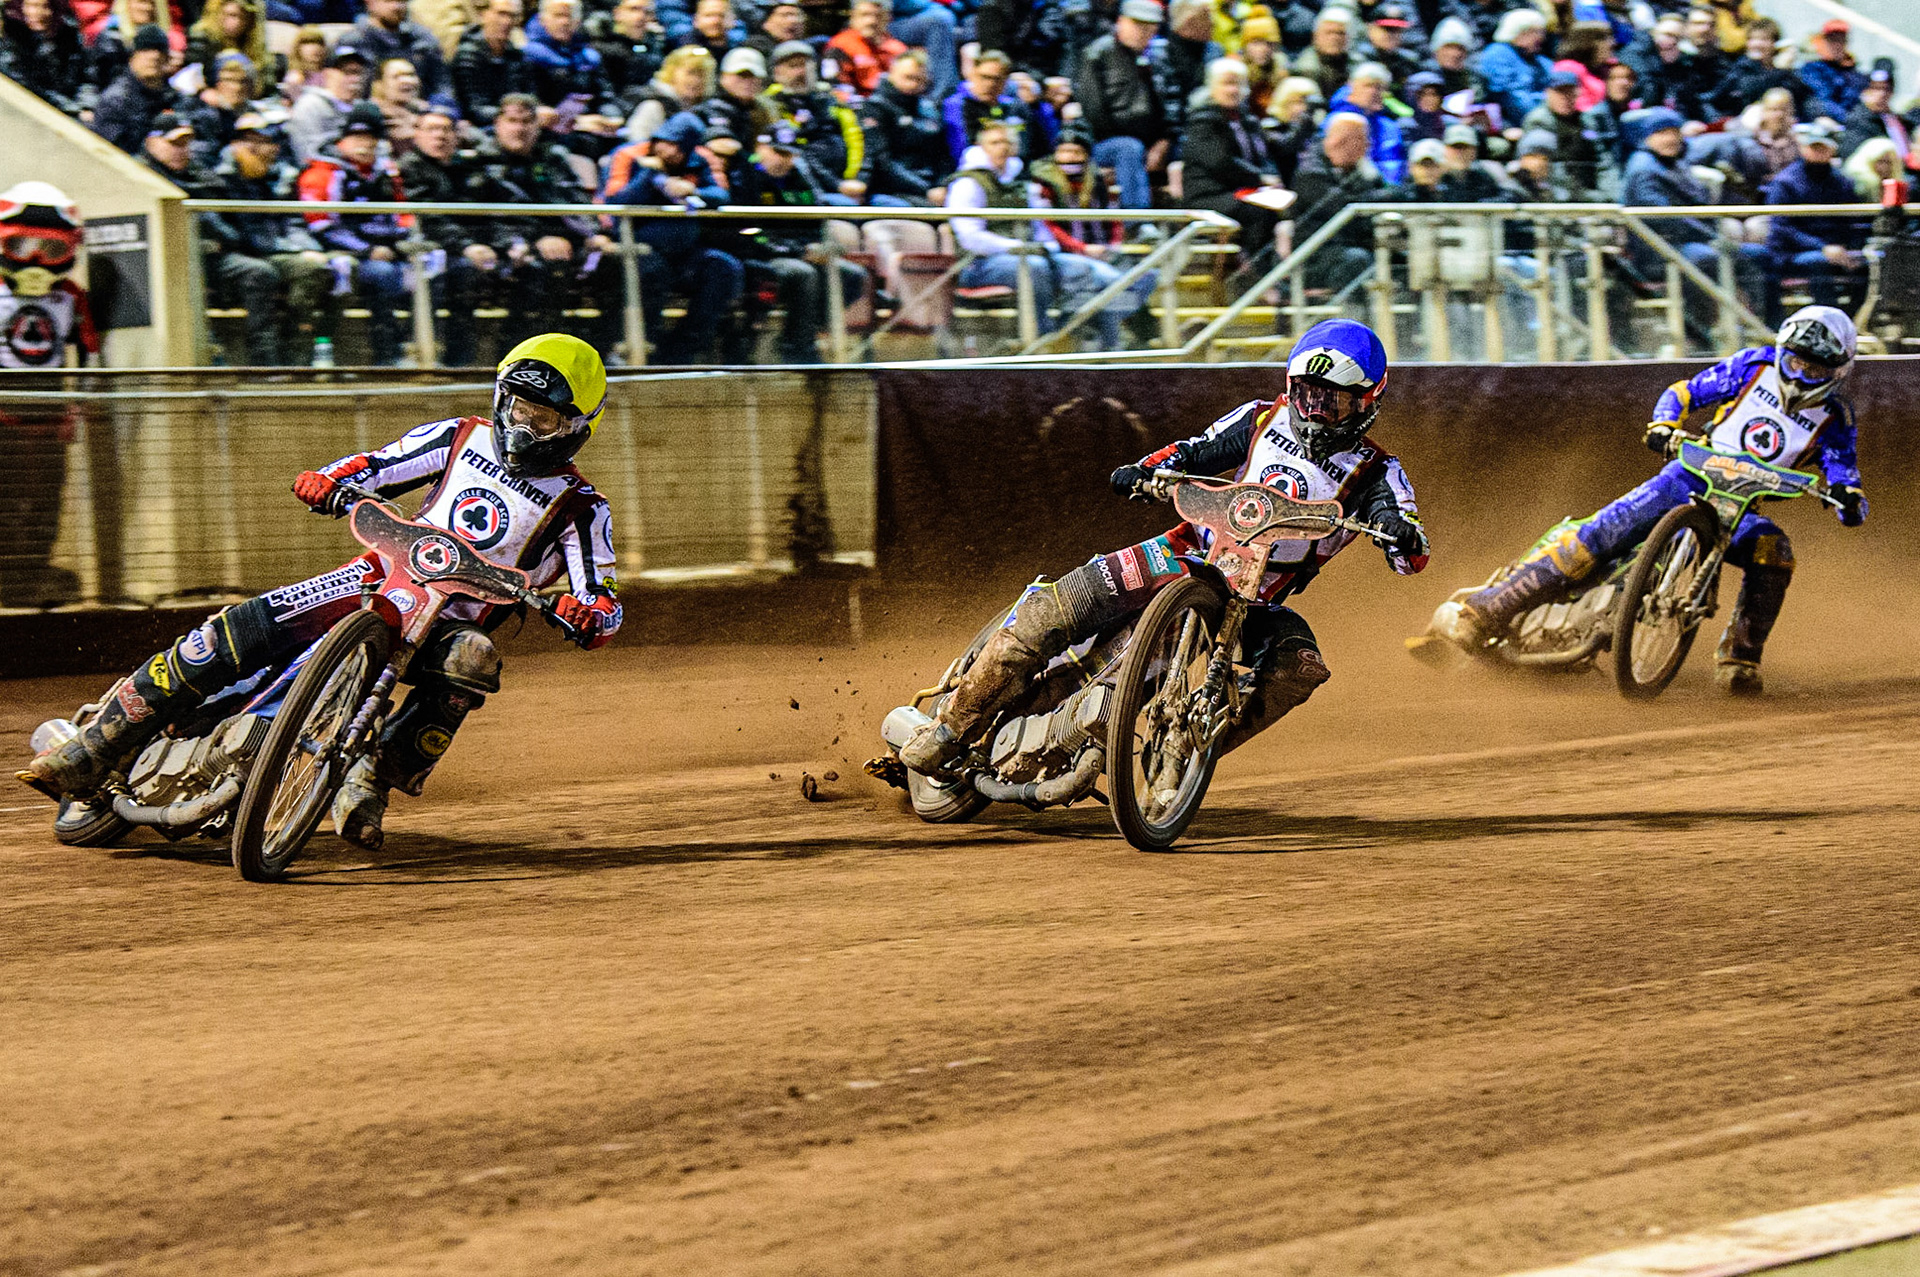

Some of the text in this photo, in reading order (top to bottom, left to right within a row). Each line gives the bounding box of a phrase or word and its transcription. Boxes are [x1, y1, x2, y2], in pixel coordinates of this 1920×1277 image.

[1754, 385, 1780, 409] PETER
[1781, 408, 1817, 432] AVEN
[1264, 428, 1347, 484] PETER AVEN
[1352, 440, 1376, 463] 14
[460, 448, 553, 509] PETER CRAVEN
[1261, 465, 1283, 479] BELLE
[1286, 468, 1302, 479] VUE
[456, 489, 508, 529] BELLE VUE ACES
[1148, 539, 1171, 573] OTOREX
[1097, 559, 1119, 597] DOCUFY
